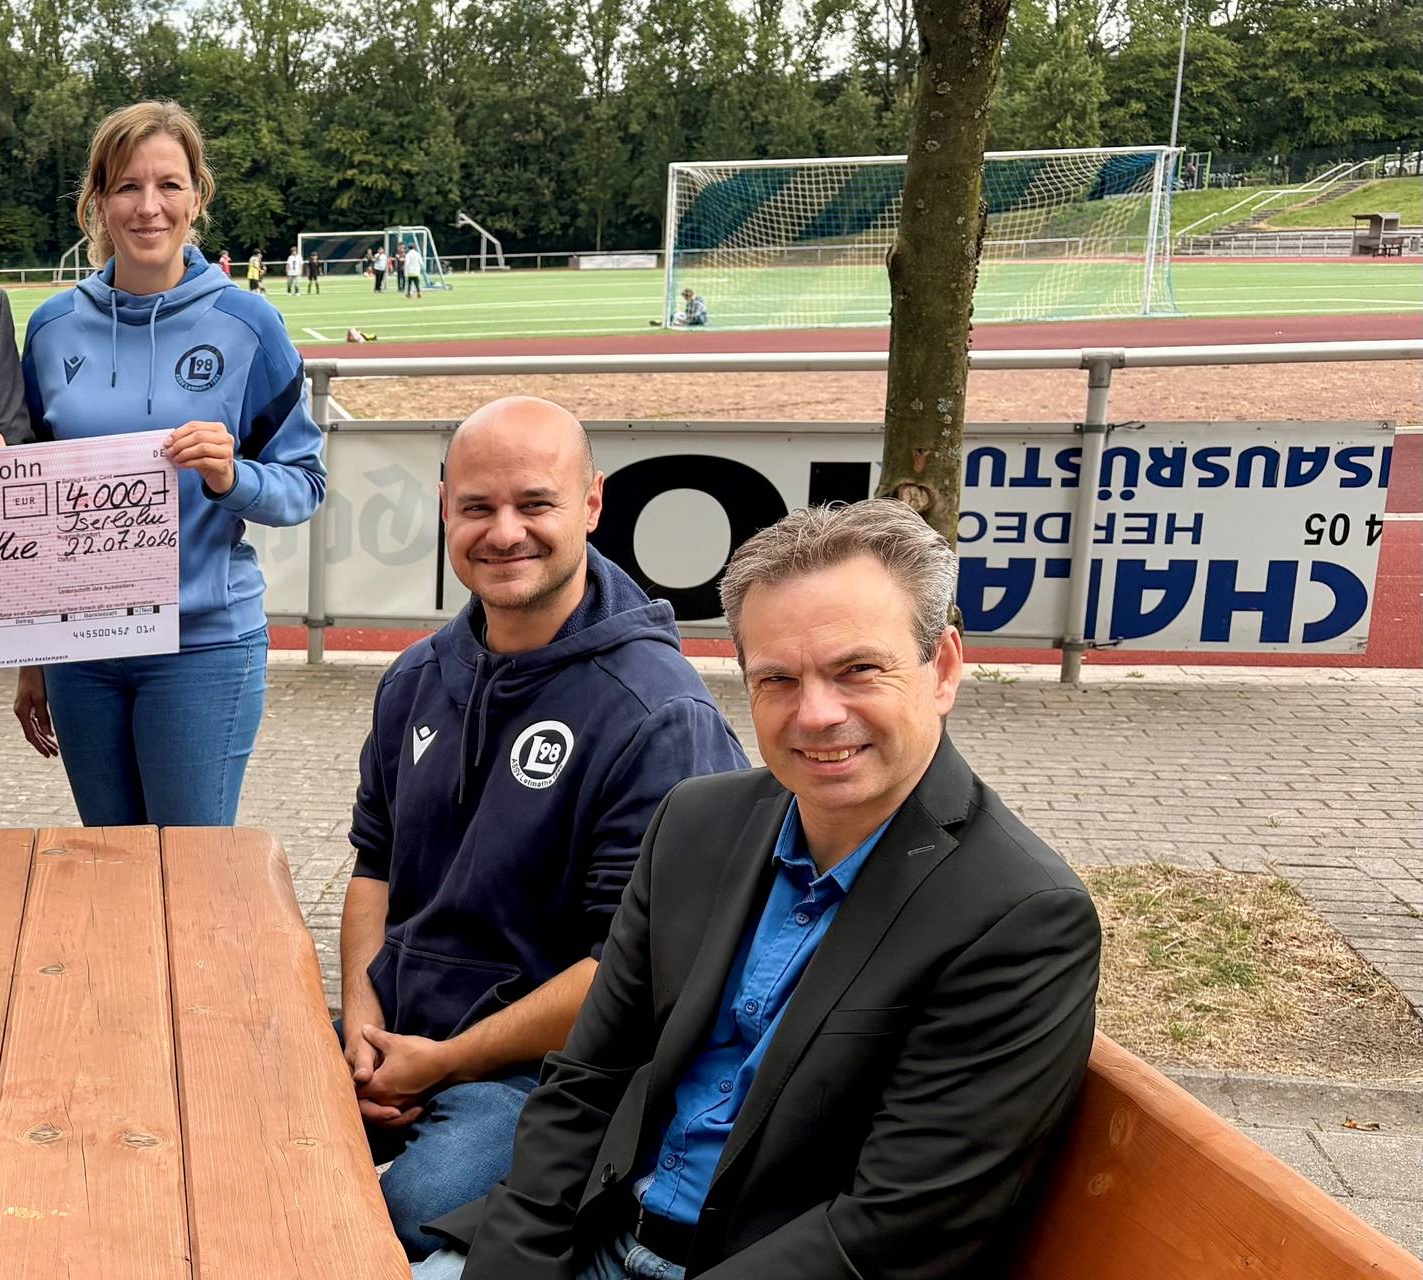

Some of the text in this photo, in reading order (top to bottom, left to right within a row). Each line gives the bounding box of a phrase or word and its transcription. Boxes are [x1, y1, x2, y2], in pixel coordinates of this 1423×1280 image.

[15, 497, 36, 506] EUR
[63, 528, 178, 557] 22.07.2026
[1304, 513, 1350, 547] 05
